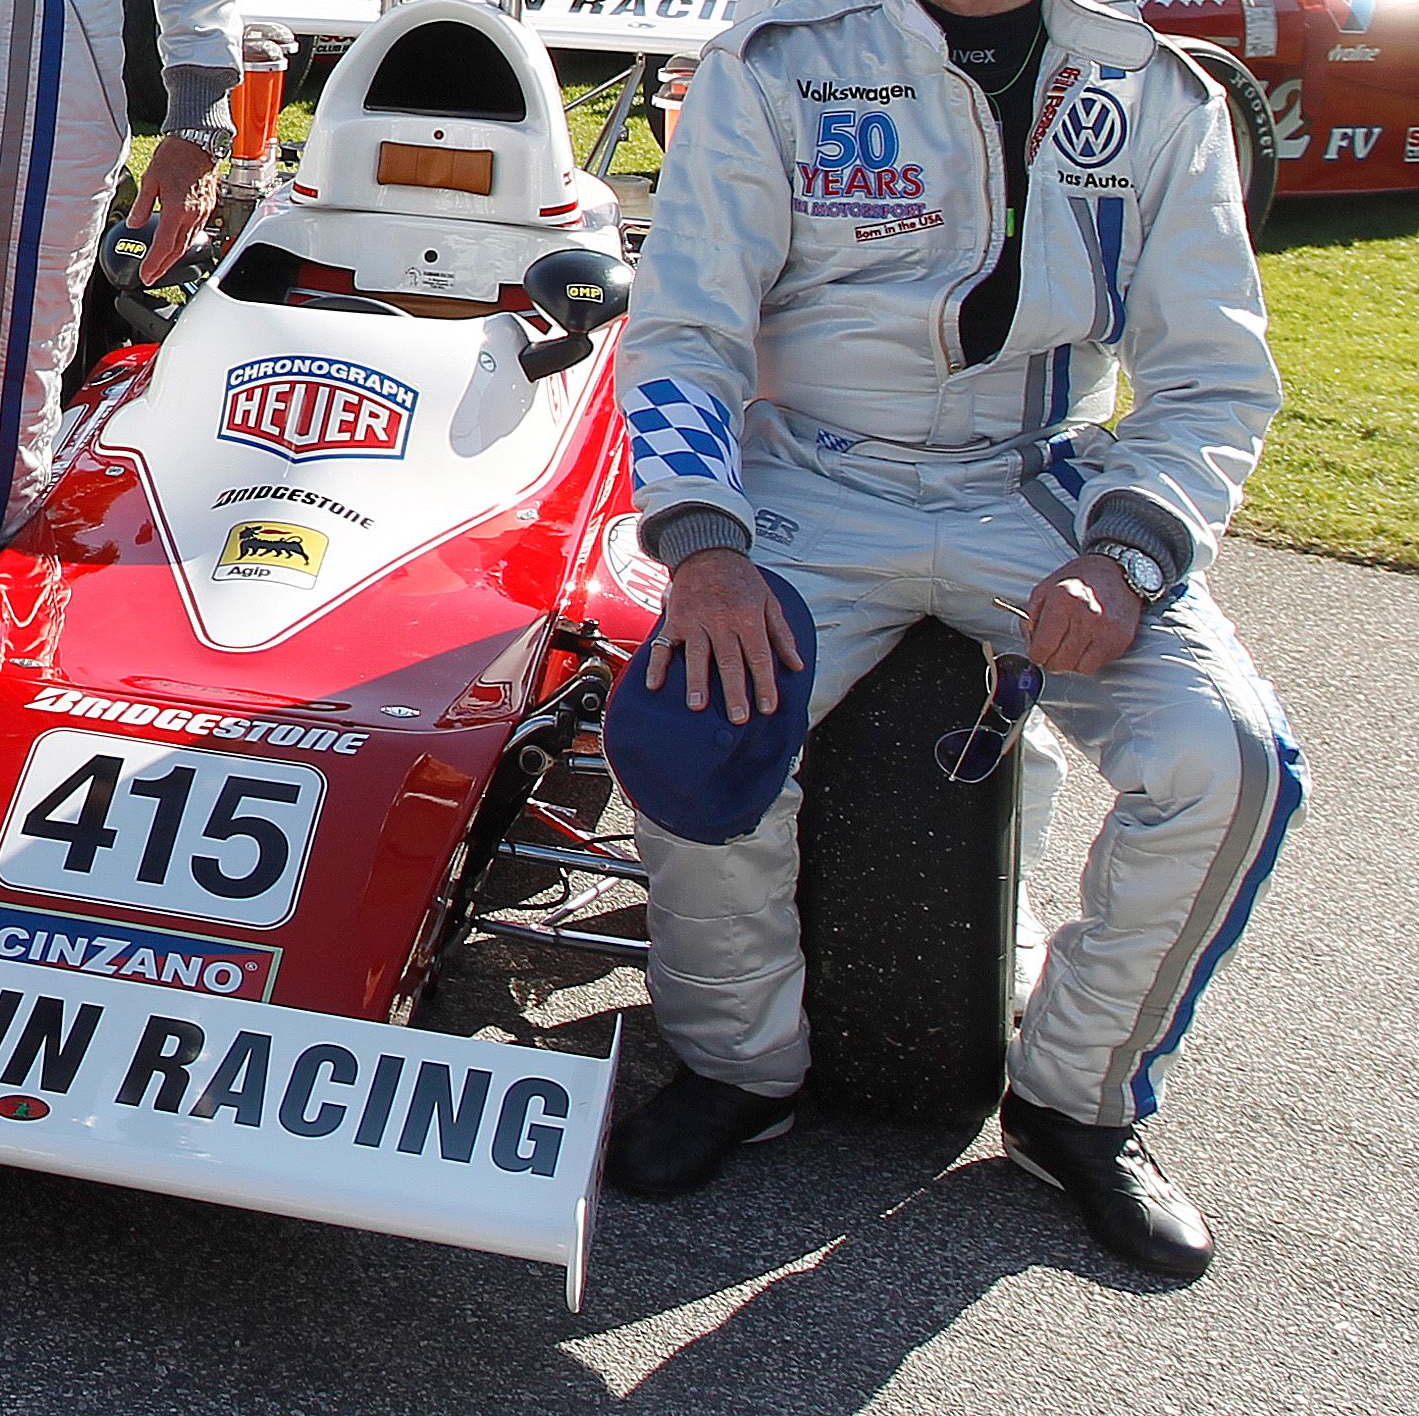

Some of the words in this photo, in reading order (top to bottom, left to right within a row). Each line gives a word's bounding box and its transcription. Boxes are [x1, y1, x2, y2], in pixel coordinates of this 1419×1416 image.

[796, 79, 916, 105] Volkswagen
[814, 110, 900, 172] 50
[1323, 127, 1383, 161] FV
[795, 161, 925, 200] YEARS
[1083, 172, 1135, 189] Auto.
[812, 201, 926, 219] MOTORSPORT
[855, 226, 881, 240] Born
[884, 223, 896, 234] in
[898, 219, 917, 232] the
[918, 213, 944, 226] USA
[117, 241, 144, 255] OMP
[569, 286, 601, 299] OMP
[229, 359, 413, 408] CHRONOGRAPH
[233, 383, 390, 446] HEUER
[210, 485, 376, 530] BRIDGESTONE
[226, 565, 272, 580] Agip
[24, 686, 369, 755] BRIDGESTONE
[21, 754, 302, 901] 415
[118, 1015, 570, 1179] RACING
